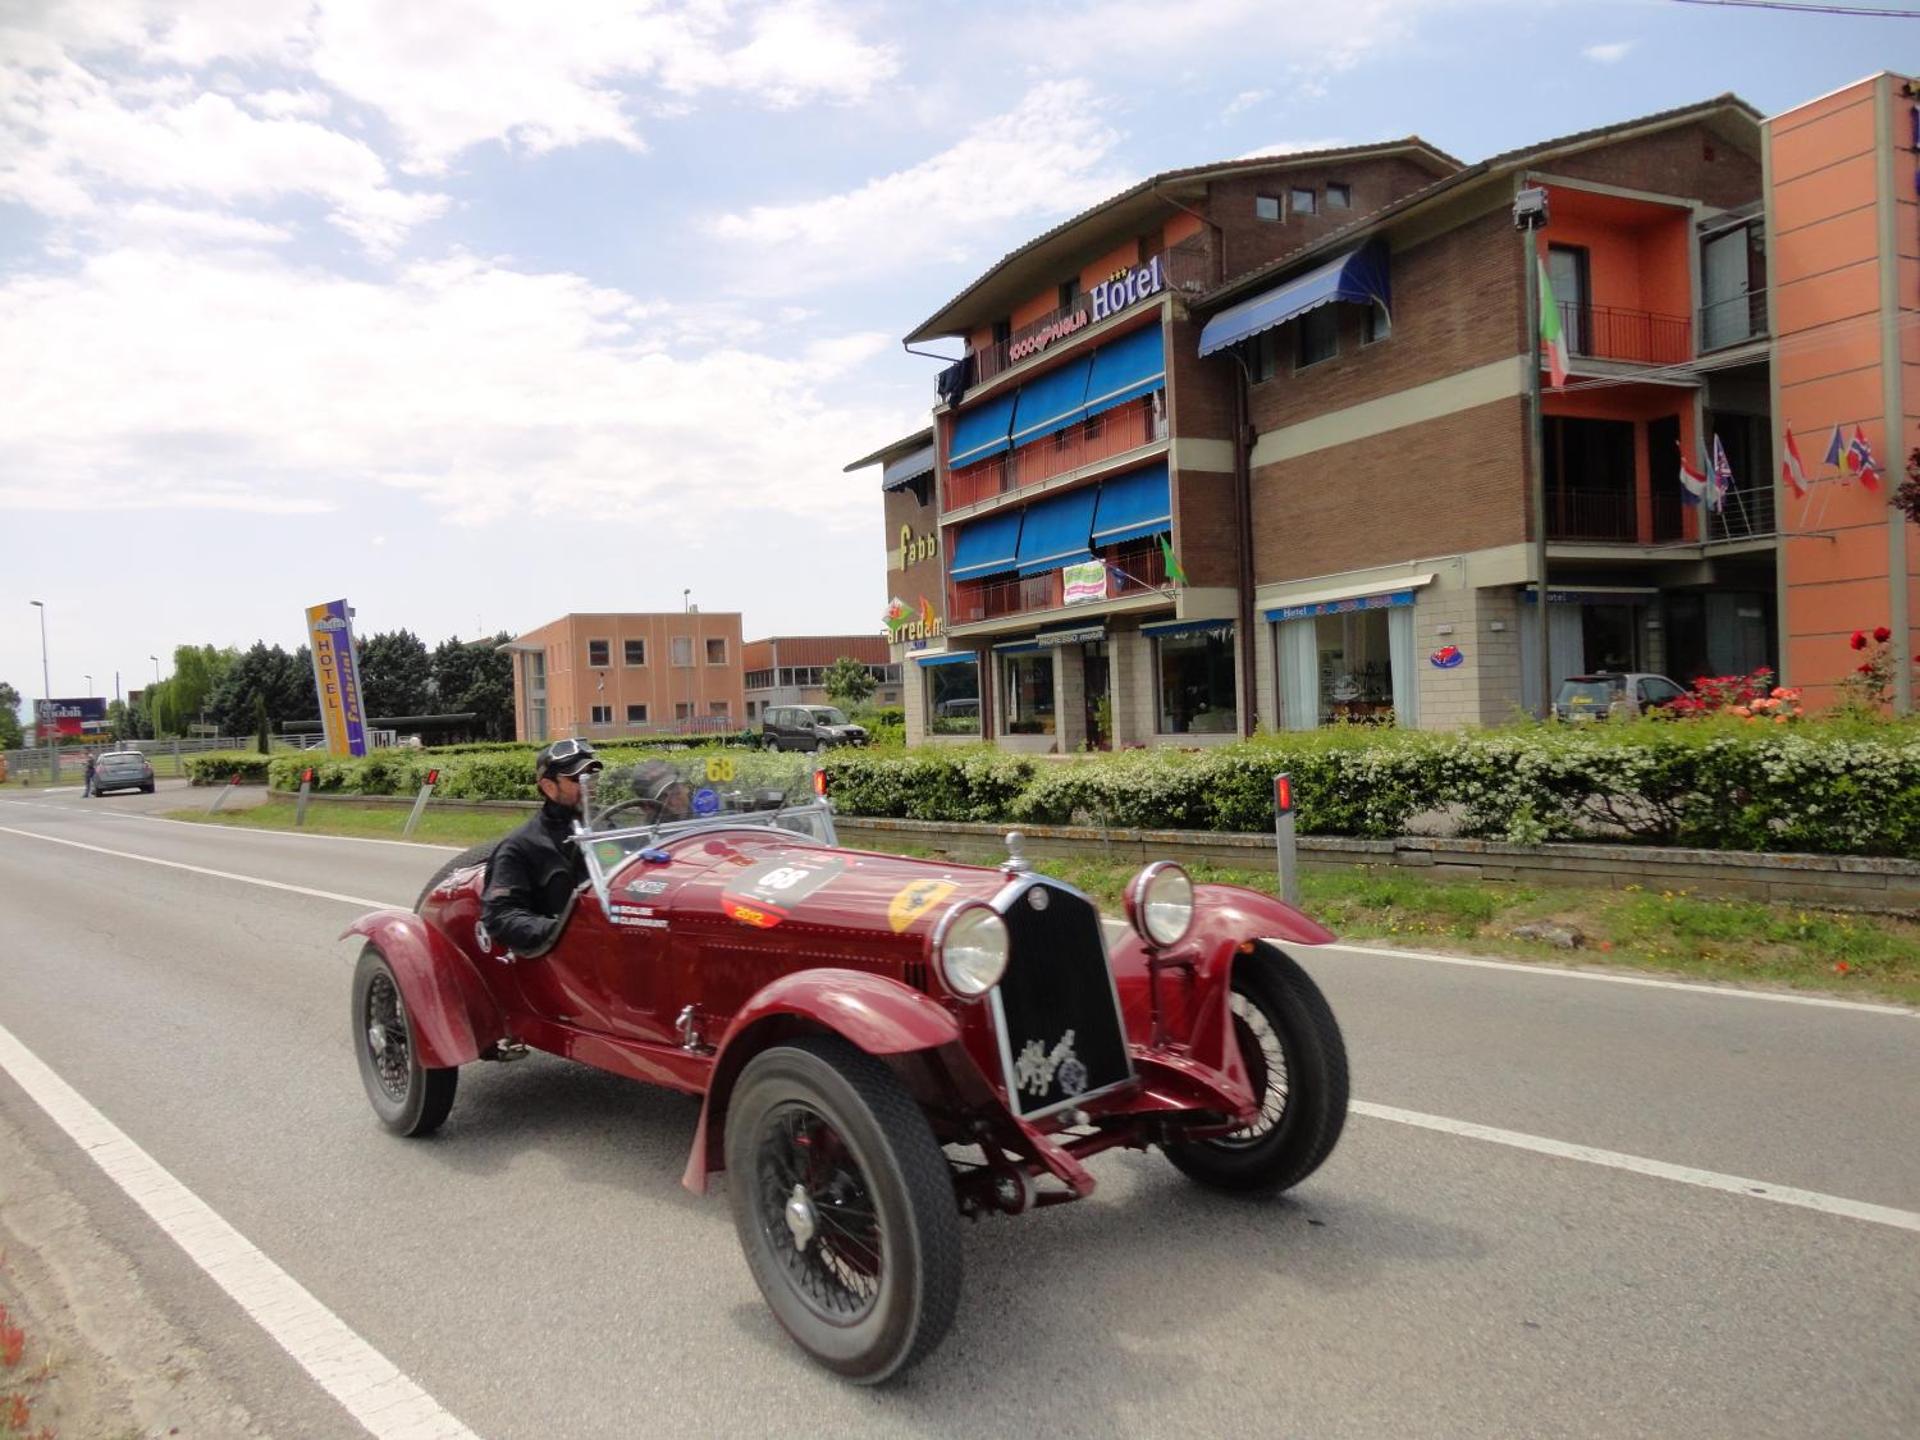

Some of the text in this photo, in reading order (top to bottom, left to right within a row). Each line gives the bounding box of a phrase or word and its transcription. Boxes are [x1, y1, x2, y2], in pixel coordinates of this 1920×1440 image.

[1090, 255, 1163, 323] Hotel
[318, 640, 338, 709] HOTEL
[706, 756, 735, 782] 68
[758, 867, 810, 890] 68
